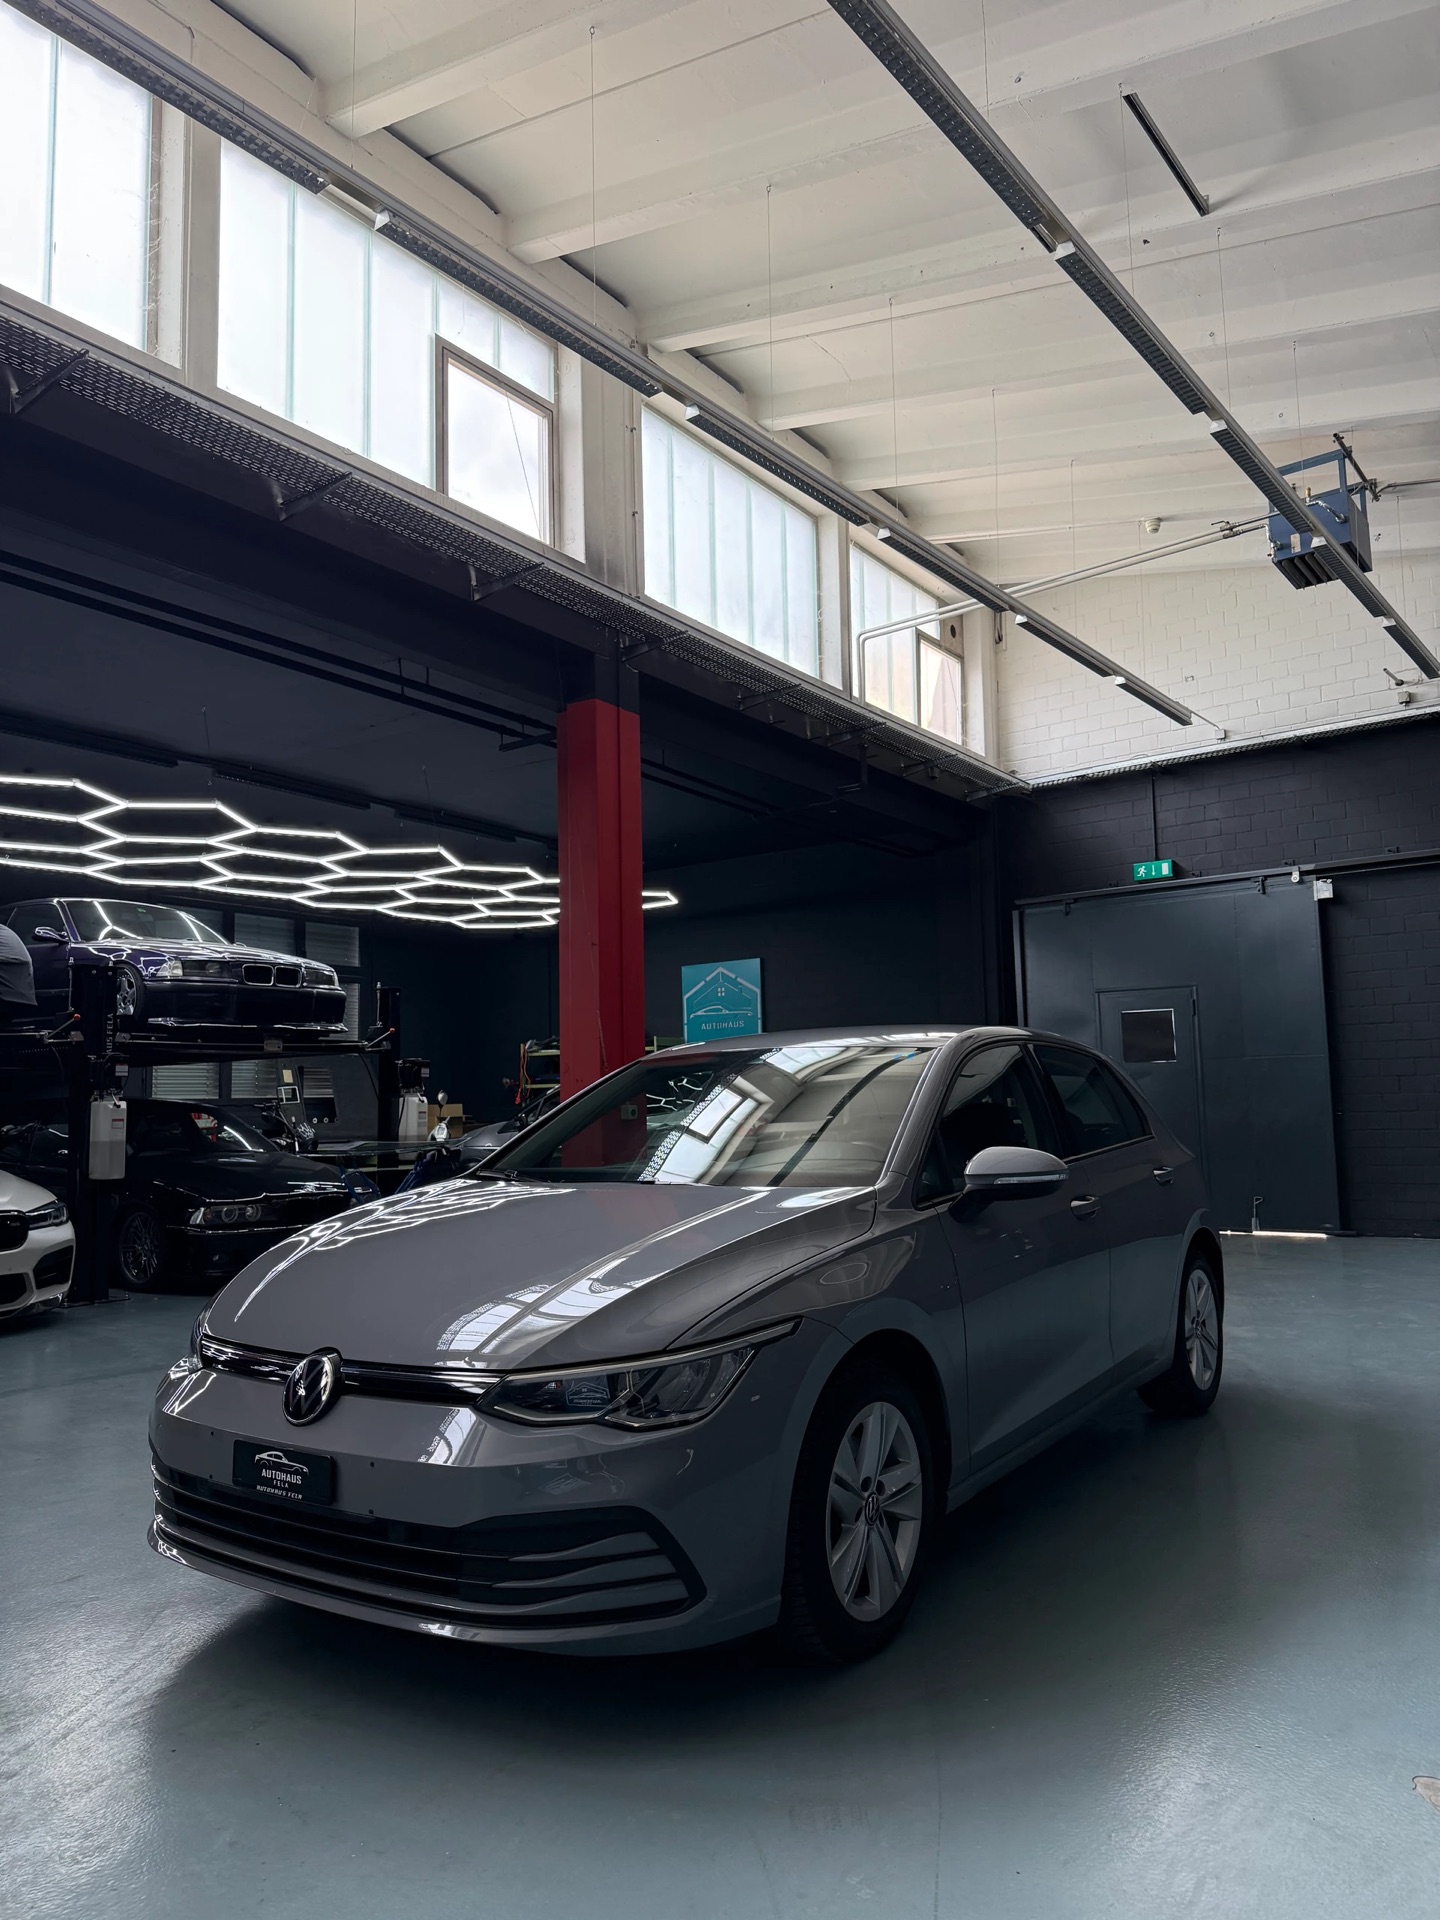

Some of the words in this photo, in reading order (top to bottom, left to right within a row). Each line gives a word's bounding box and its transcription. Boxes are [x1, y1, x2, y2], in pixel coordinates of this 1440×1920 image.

[106, 1013, 114, 1035] FELA
[701, 1020, 745, 1030] AUTOHAUS
[261, 1468, 302, 1485] AUTOHAUS
[273, 1479, 289, 1489] FELA
